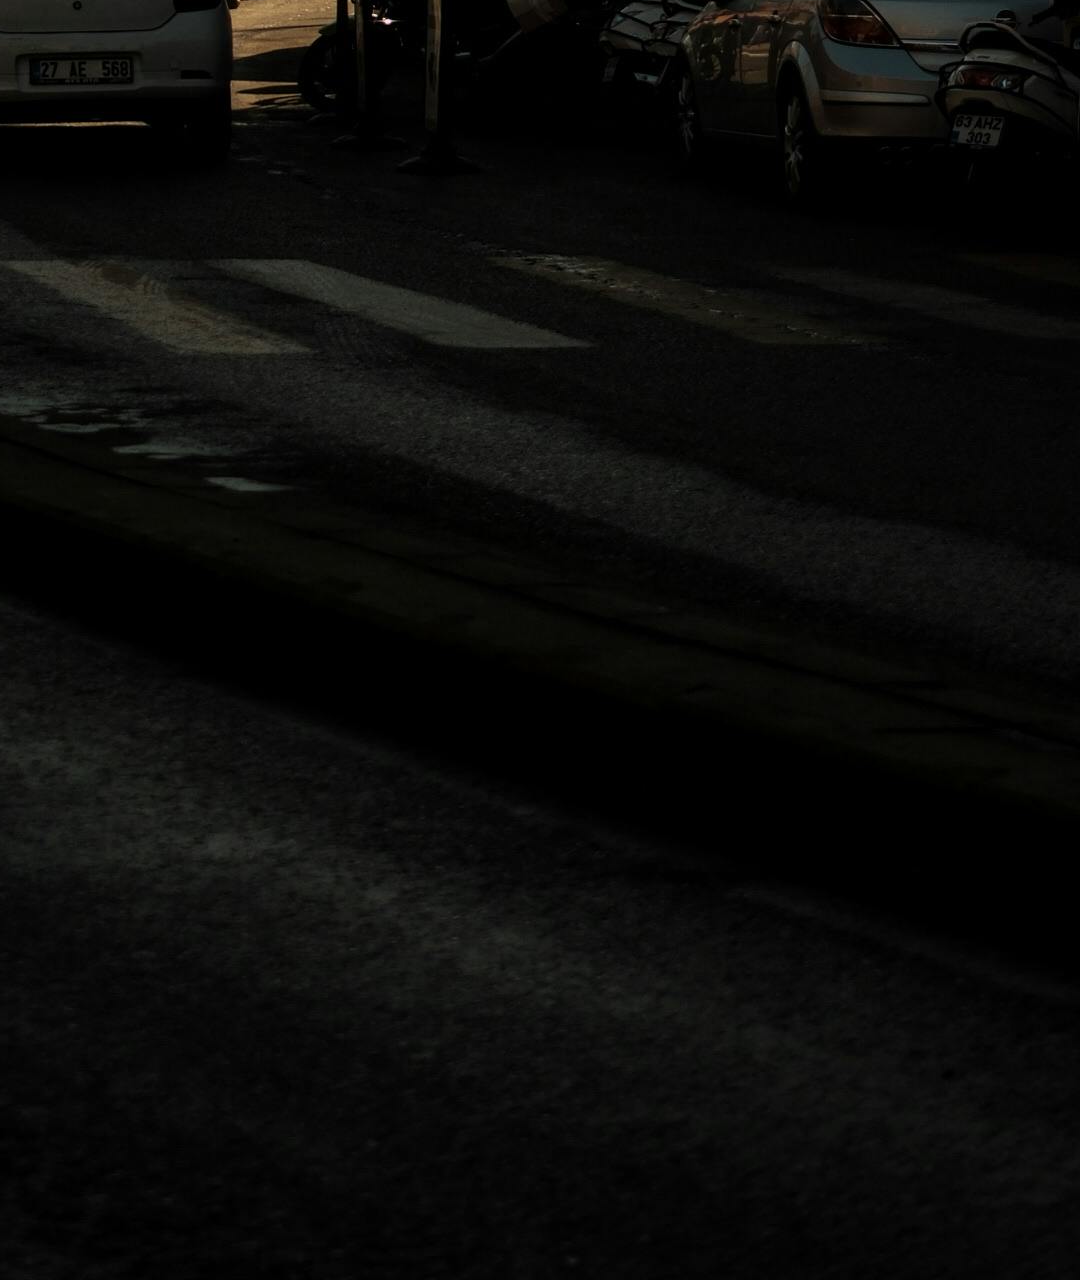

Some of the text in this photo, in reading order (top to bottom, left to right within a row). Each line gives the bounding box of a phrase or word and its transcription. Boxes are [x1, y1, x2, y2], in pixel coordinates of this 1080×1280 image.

[40, 61, 130, 78] 27 AE 568
[955, 115, 1002, 130] 63 AHZ
[966, 131, 991, 144] 303
